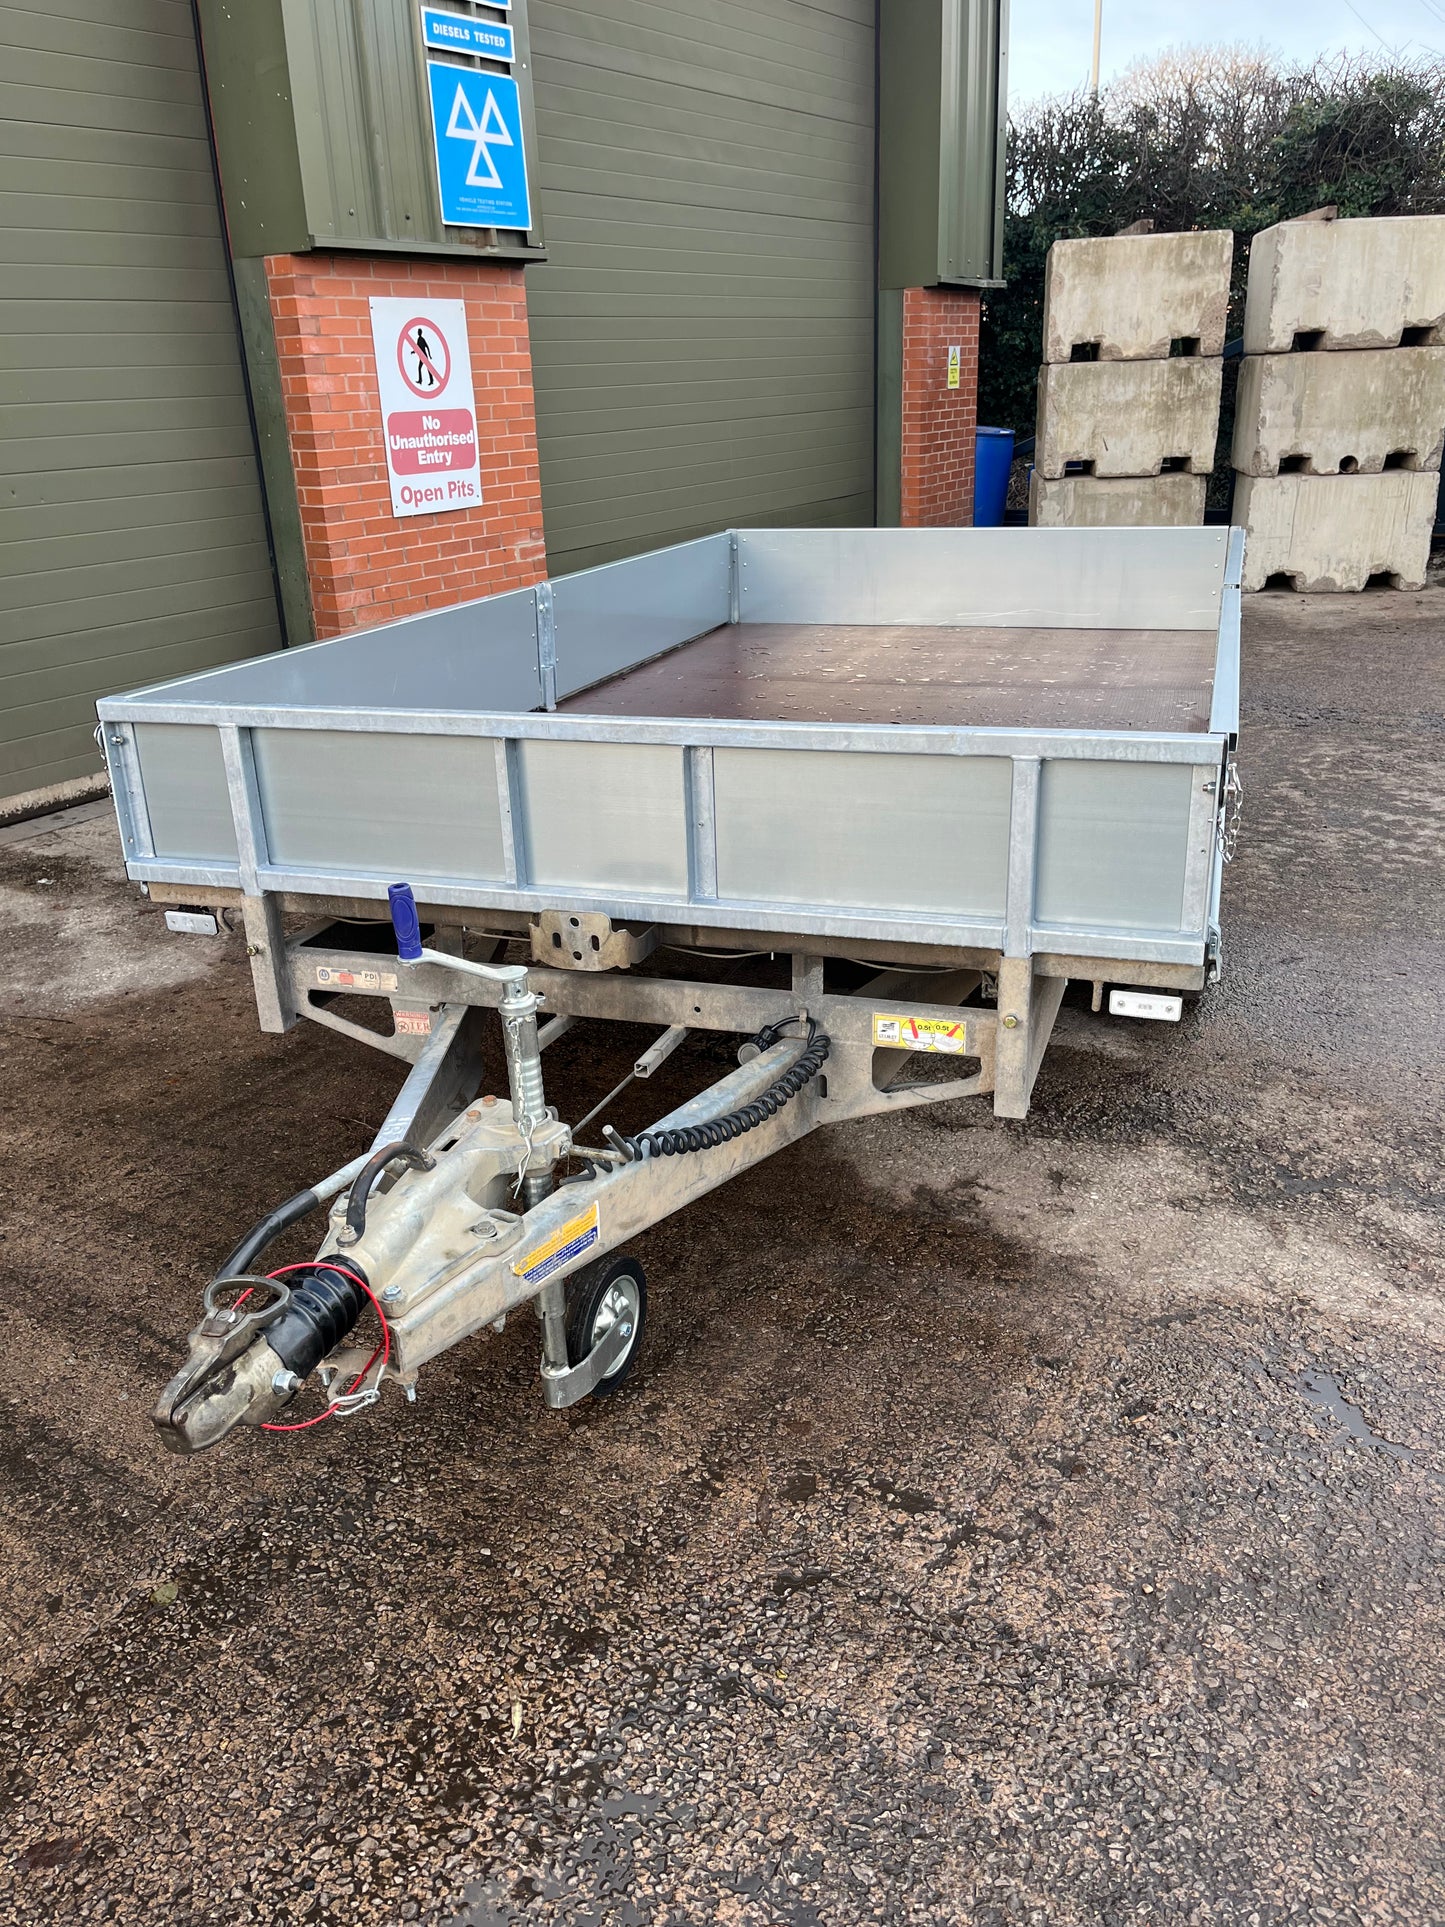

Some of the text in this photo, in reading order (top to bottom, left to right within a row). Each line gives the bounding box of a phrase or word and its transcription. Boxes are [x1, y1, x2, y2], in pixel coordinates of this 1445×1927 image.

[432, 22, 506, 48] DIESELS TESTED
[422, 415, 441, 431] No
[390, 430, 474, 450] Unauthorised
[417, 450, 453, 466] Entry
[400, 480, 475, 508] Open Pits
[935, 1024, 950, 1032] 0.5t
